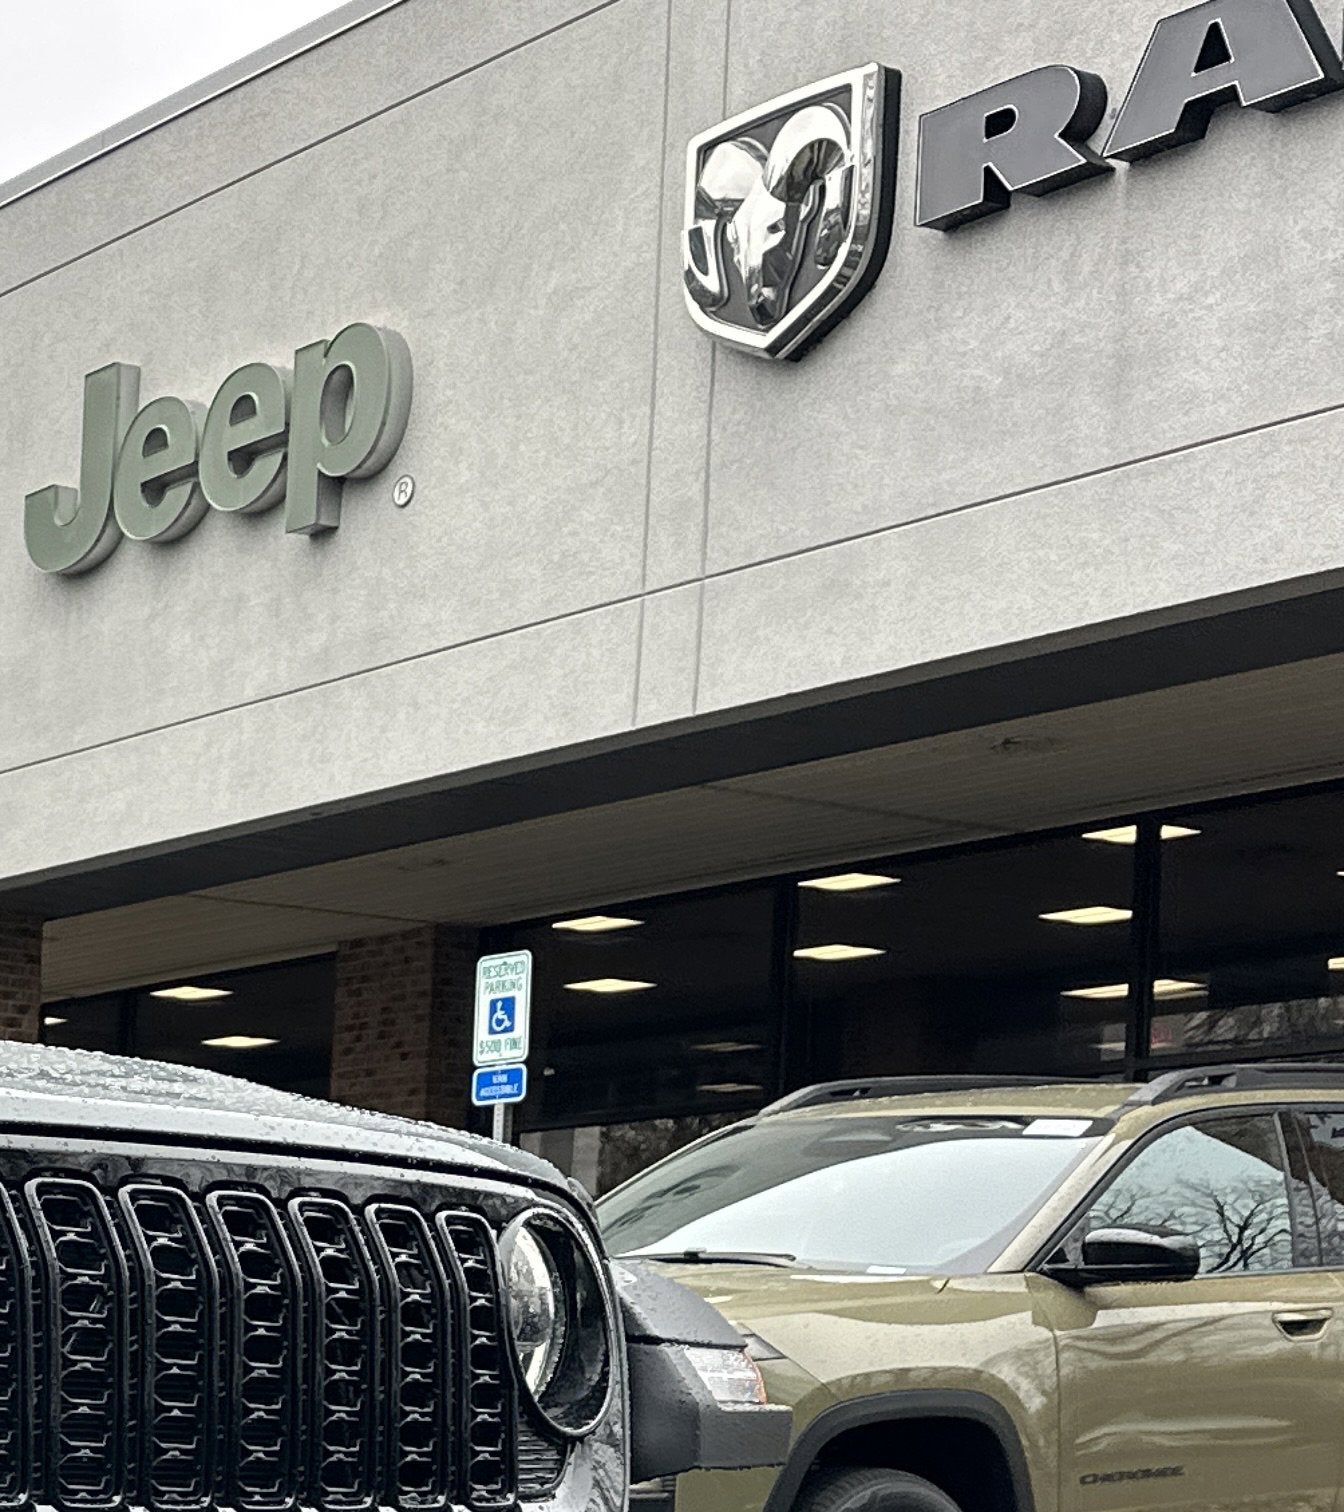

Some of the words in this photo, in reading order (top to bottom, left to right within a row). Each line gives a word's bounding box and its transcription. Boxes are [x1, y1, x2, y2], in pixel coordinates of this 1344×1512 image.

[915, 0, 1344, 231] RA
[24, 321, 413, 576] Jeep
[482, 960, 525, 979] RESERVED
[483, 977, 523, 995] PARKING
